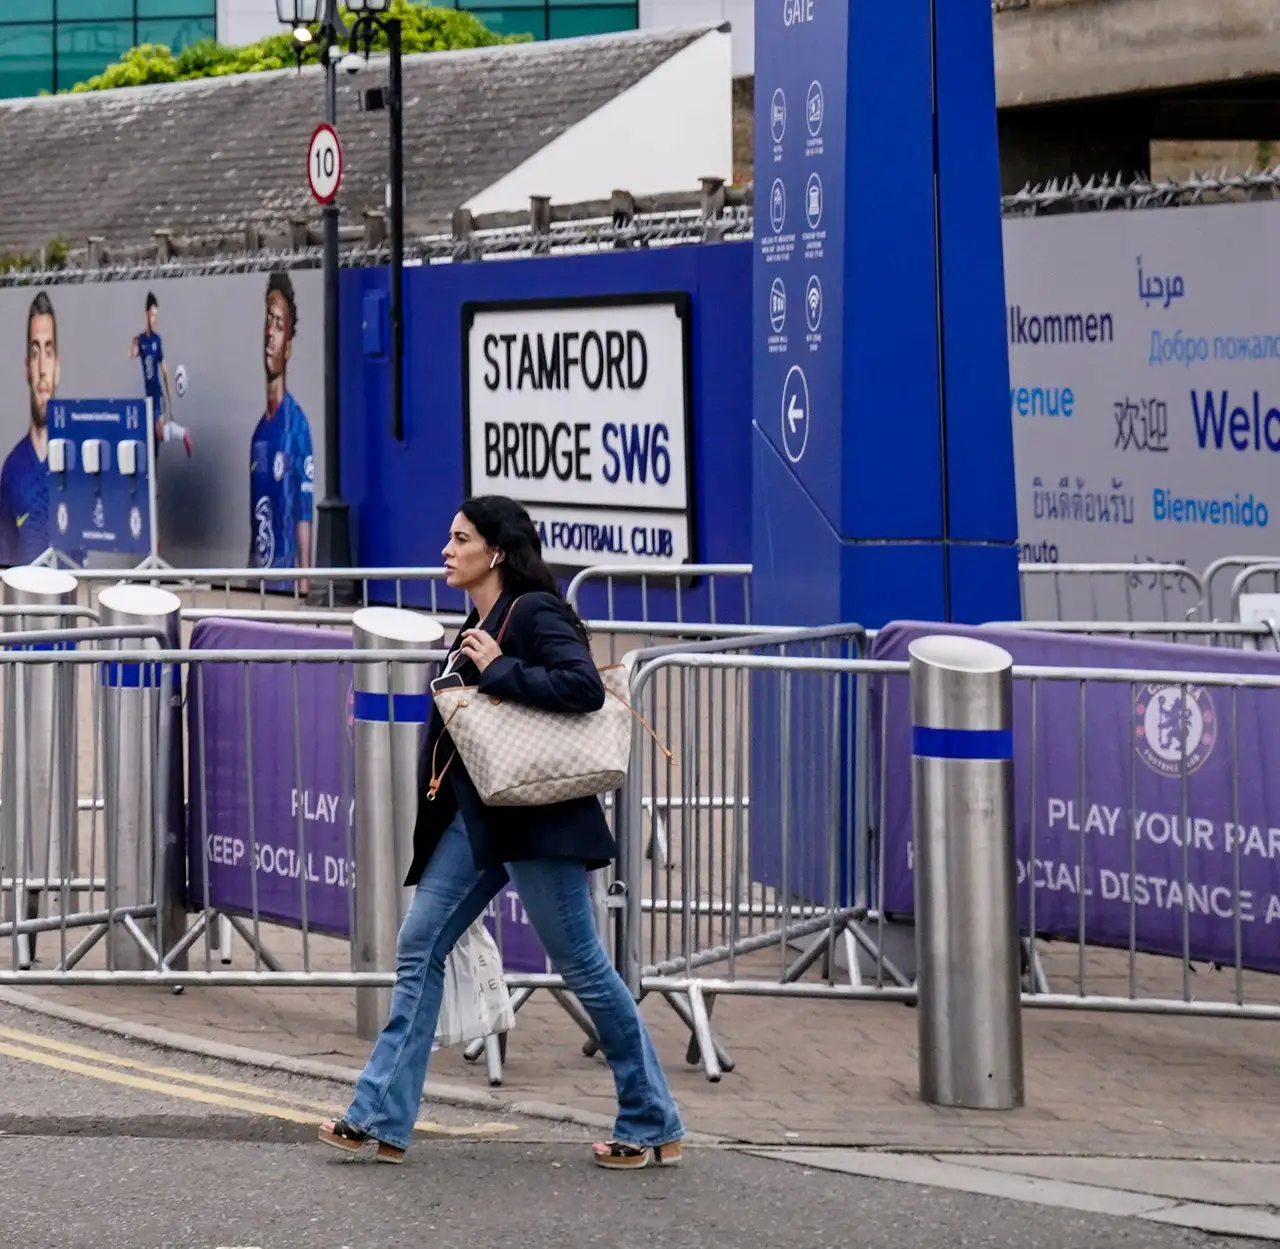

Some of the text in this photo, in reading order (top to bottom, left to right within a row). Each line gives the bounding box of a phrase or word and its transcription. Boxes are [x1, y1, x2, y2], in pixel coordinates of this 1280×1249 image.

[315, 147, 334, 178] 10
[483, 330, 648, 392] STAMFORD
[1148, 329, 1208, 369] Добро
[1114, 396, 1169, 452] 欢迎
[484, 421, 671, 486] BRIDGE SW6
[1153, 488, 1269, 527] Bienvenido
[551, 521, 628, 555] FOOTBALL
[631, 526, 673, 557] CLUB
[291, 788, 339, 824] PLAY
[1047, 798, 1121, 837] PLAY
[1130, 810, 1215, 851] YOUR
[251, 841, 320, 883] SOCIAL
[1100, 868, 1256, 922] DISTANCE
